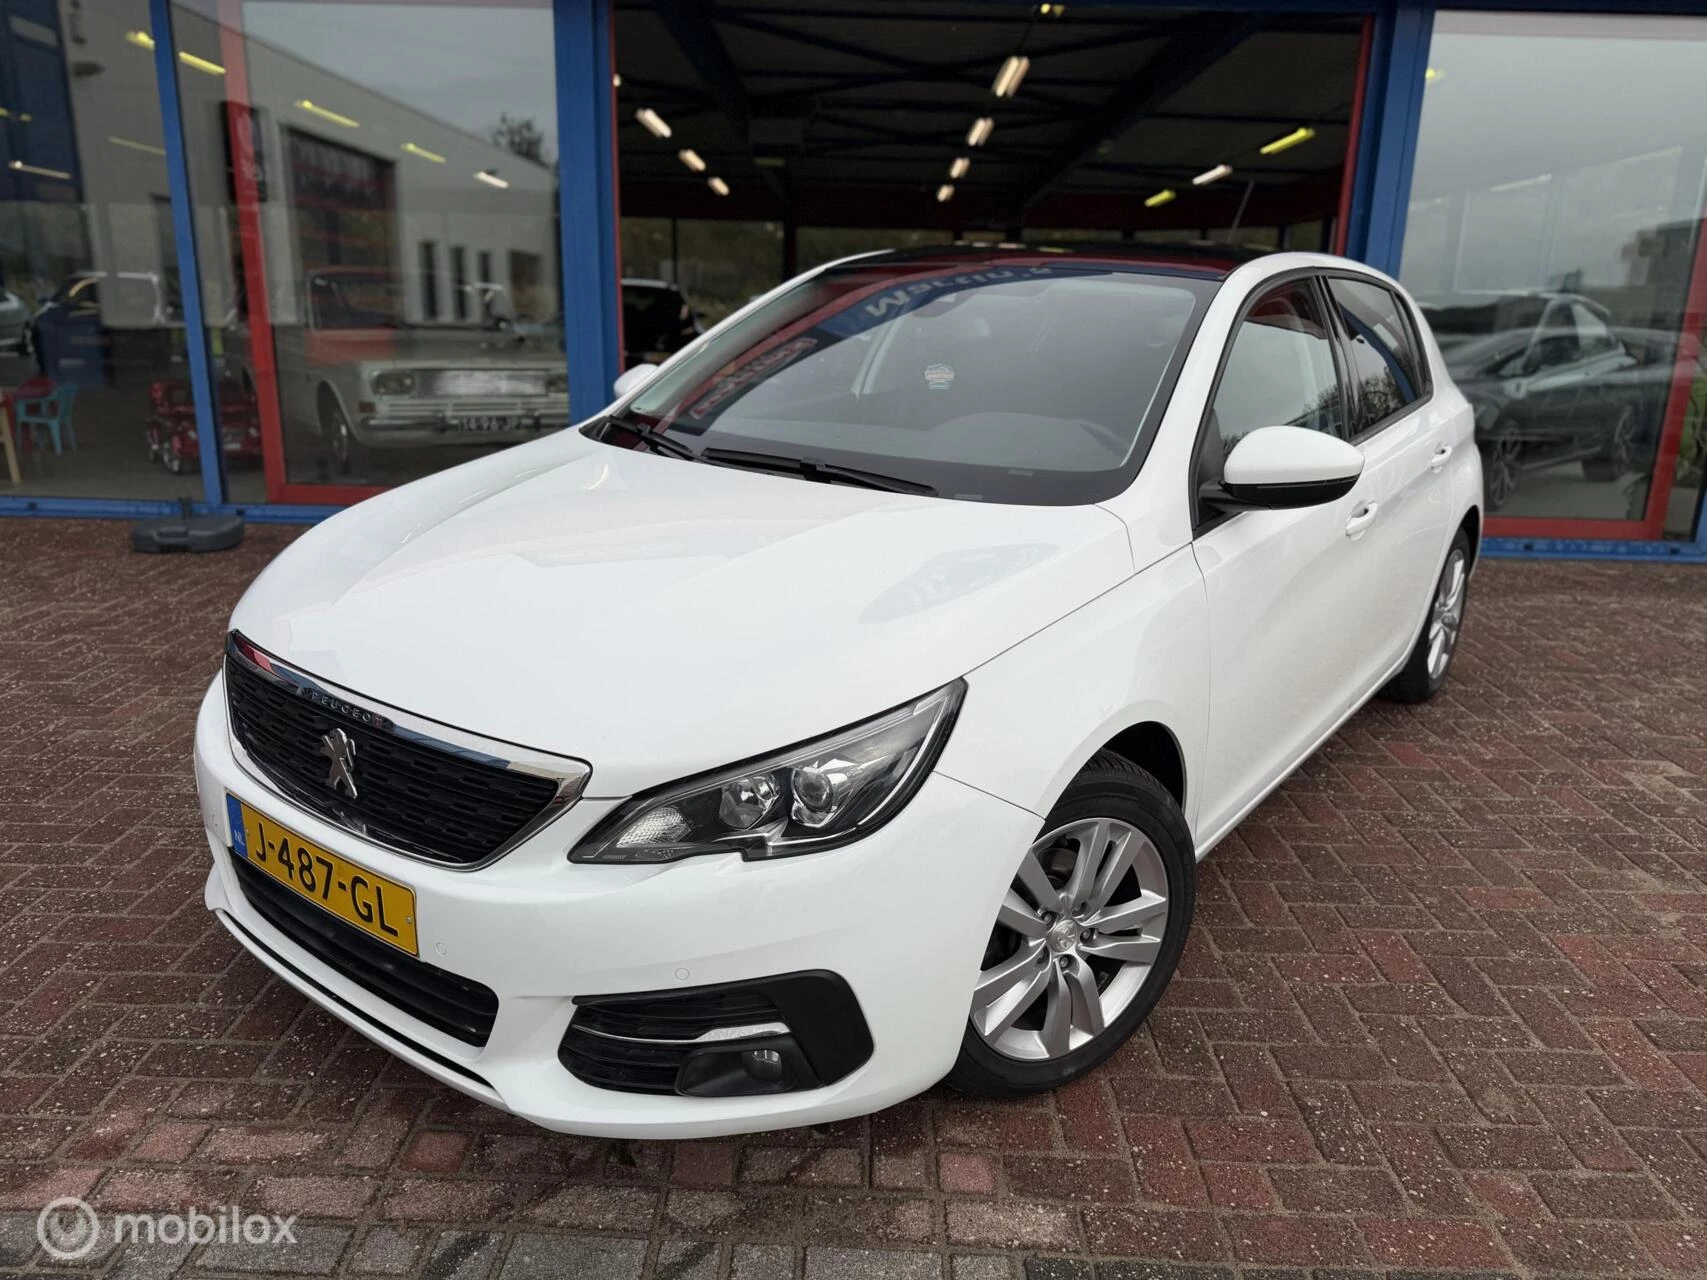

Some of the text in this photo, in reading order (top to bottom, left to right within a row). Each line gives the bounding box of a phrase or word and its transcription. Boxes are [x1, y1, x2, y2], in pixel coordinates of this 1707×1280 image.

[310, 690, 384, 727] PEUGEOT
[233, 830, 245, 847] NL
[256, 821, 399, 938] J-487-GL
